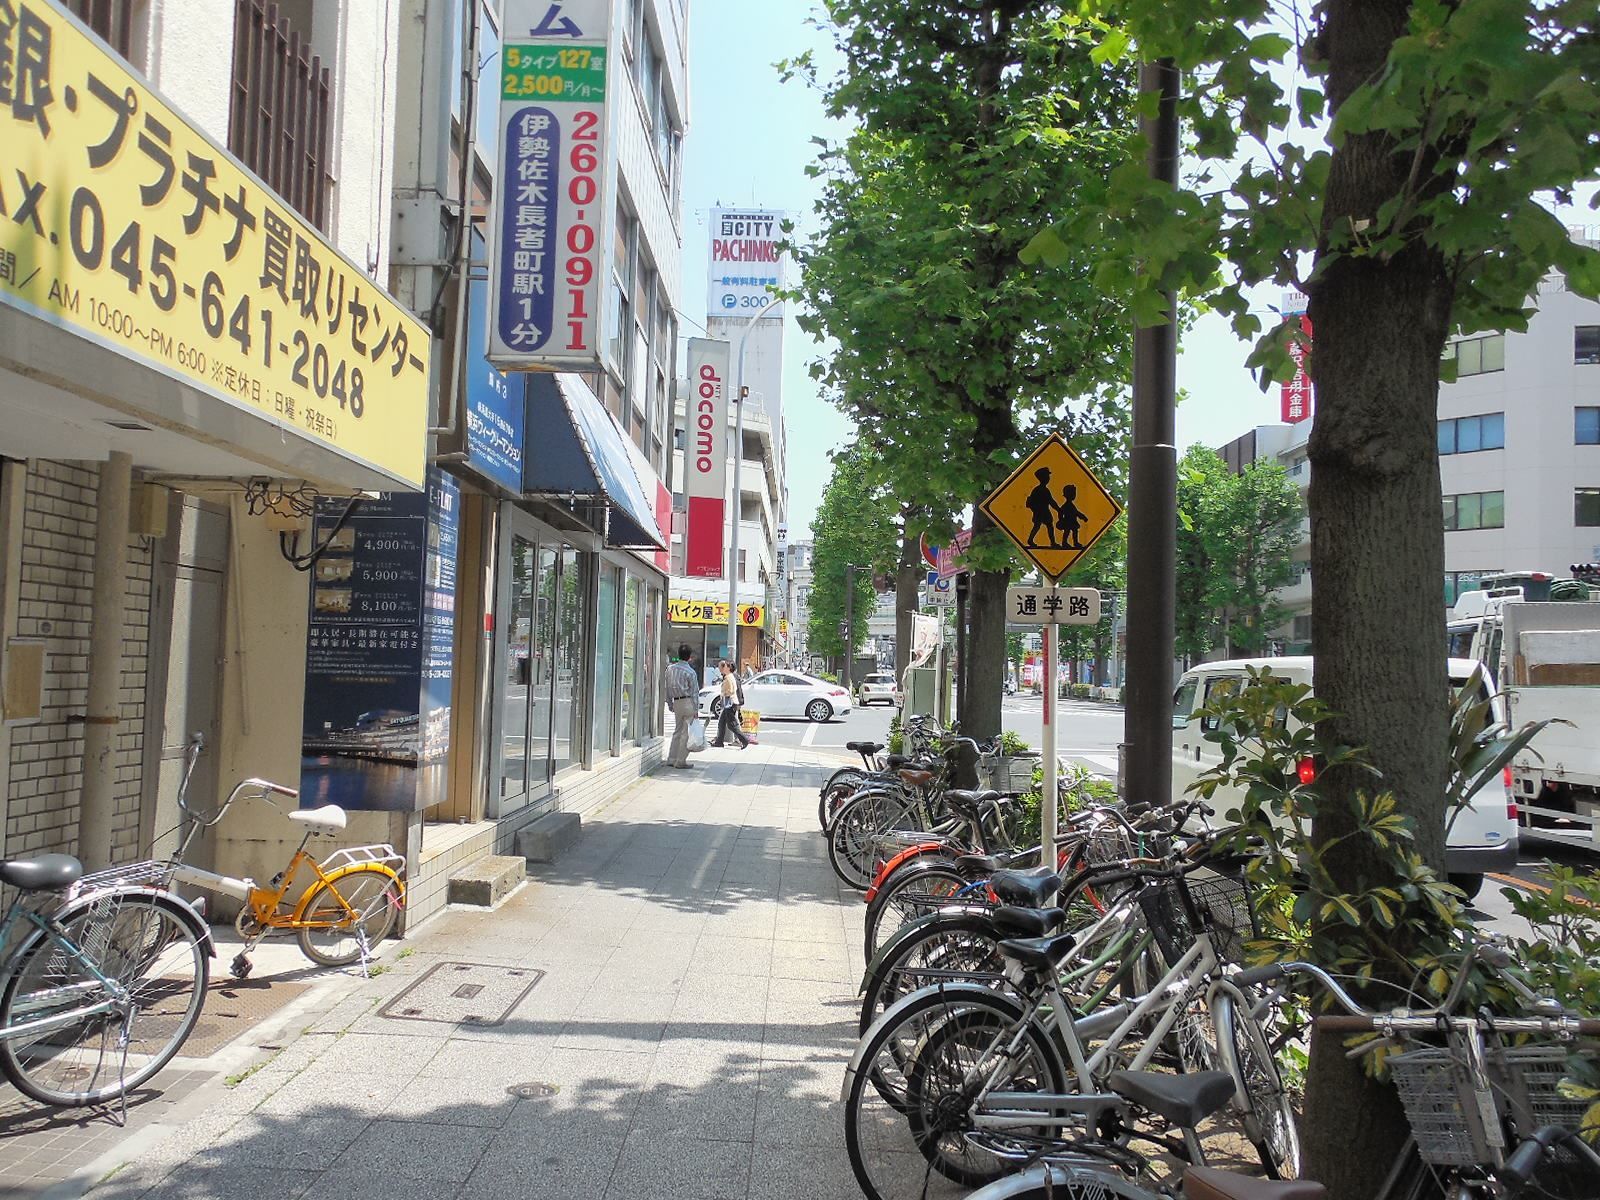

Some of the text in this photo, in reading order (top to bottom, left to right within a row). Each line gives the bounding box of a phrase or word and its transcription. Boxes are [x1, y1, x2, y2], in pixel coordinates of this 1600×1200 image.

[530, 3, 583, 38] ム
[511, 114, 551, 345] 伊勢佐木長者町駅1分
[566, 111, 598, 350] 260-0911
[735, 222, 773, 236] CITY
[713, 239, 780, 262] PACHINKO
[70, 186, 365, 419] 045-641-2048
[740, 296, 770, 307] 300
[48, 278, 80, 314] AM
[178, 342, 206, 374] 6:00
[697, 365, 721, 473] docomo
[364, 540, 399, 551] 4,900
[363, 570, 398, 581] 5,900
[361, 601, 397, 612] 8,100
[1016, 594, 1090, 617] 通学路
